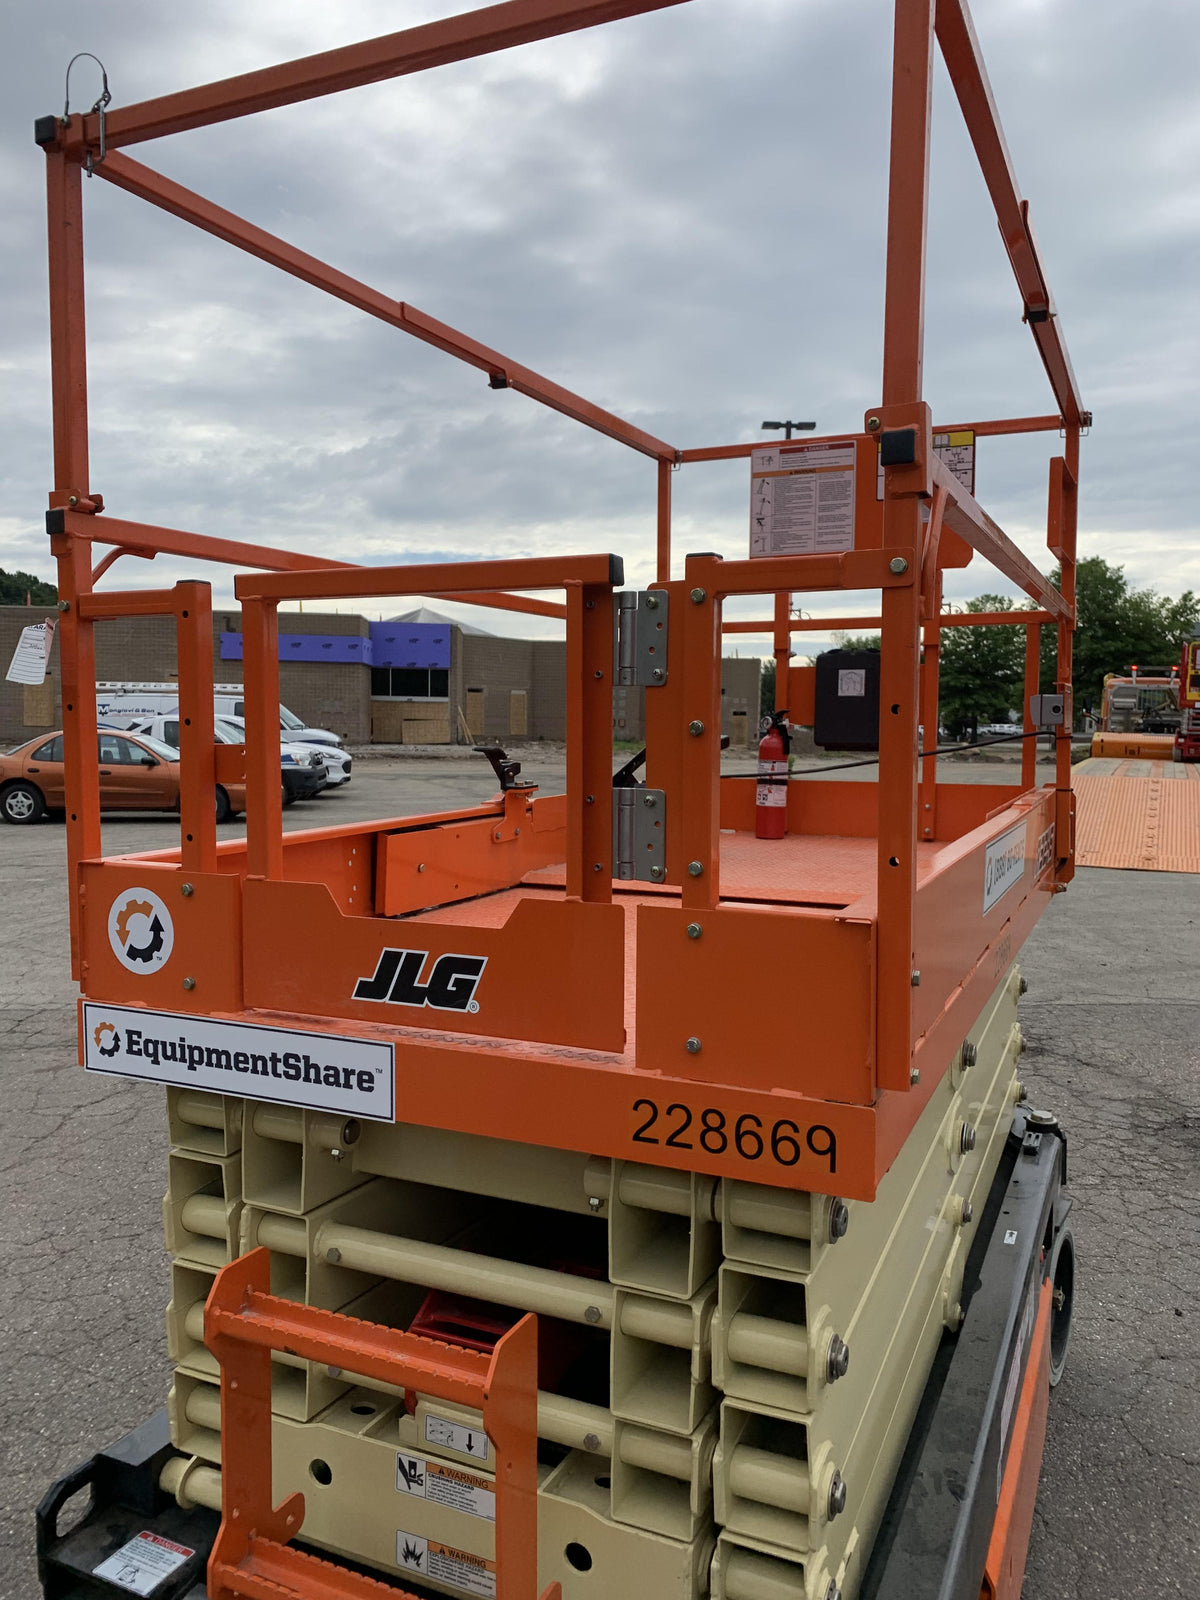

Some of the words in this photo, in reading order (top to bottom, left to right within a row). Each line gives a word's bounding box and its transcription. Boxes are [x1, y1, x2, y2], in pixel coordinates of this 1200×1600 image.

[351, 947, 488, 1013] JLG
[125, 1029, 375, 1093] EquipmentShare
[632, 1099, 837, 1173] 228669
[447, 1469, 489, 1489] WARNING
[448, 1549, 487, 1569] WARNING
